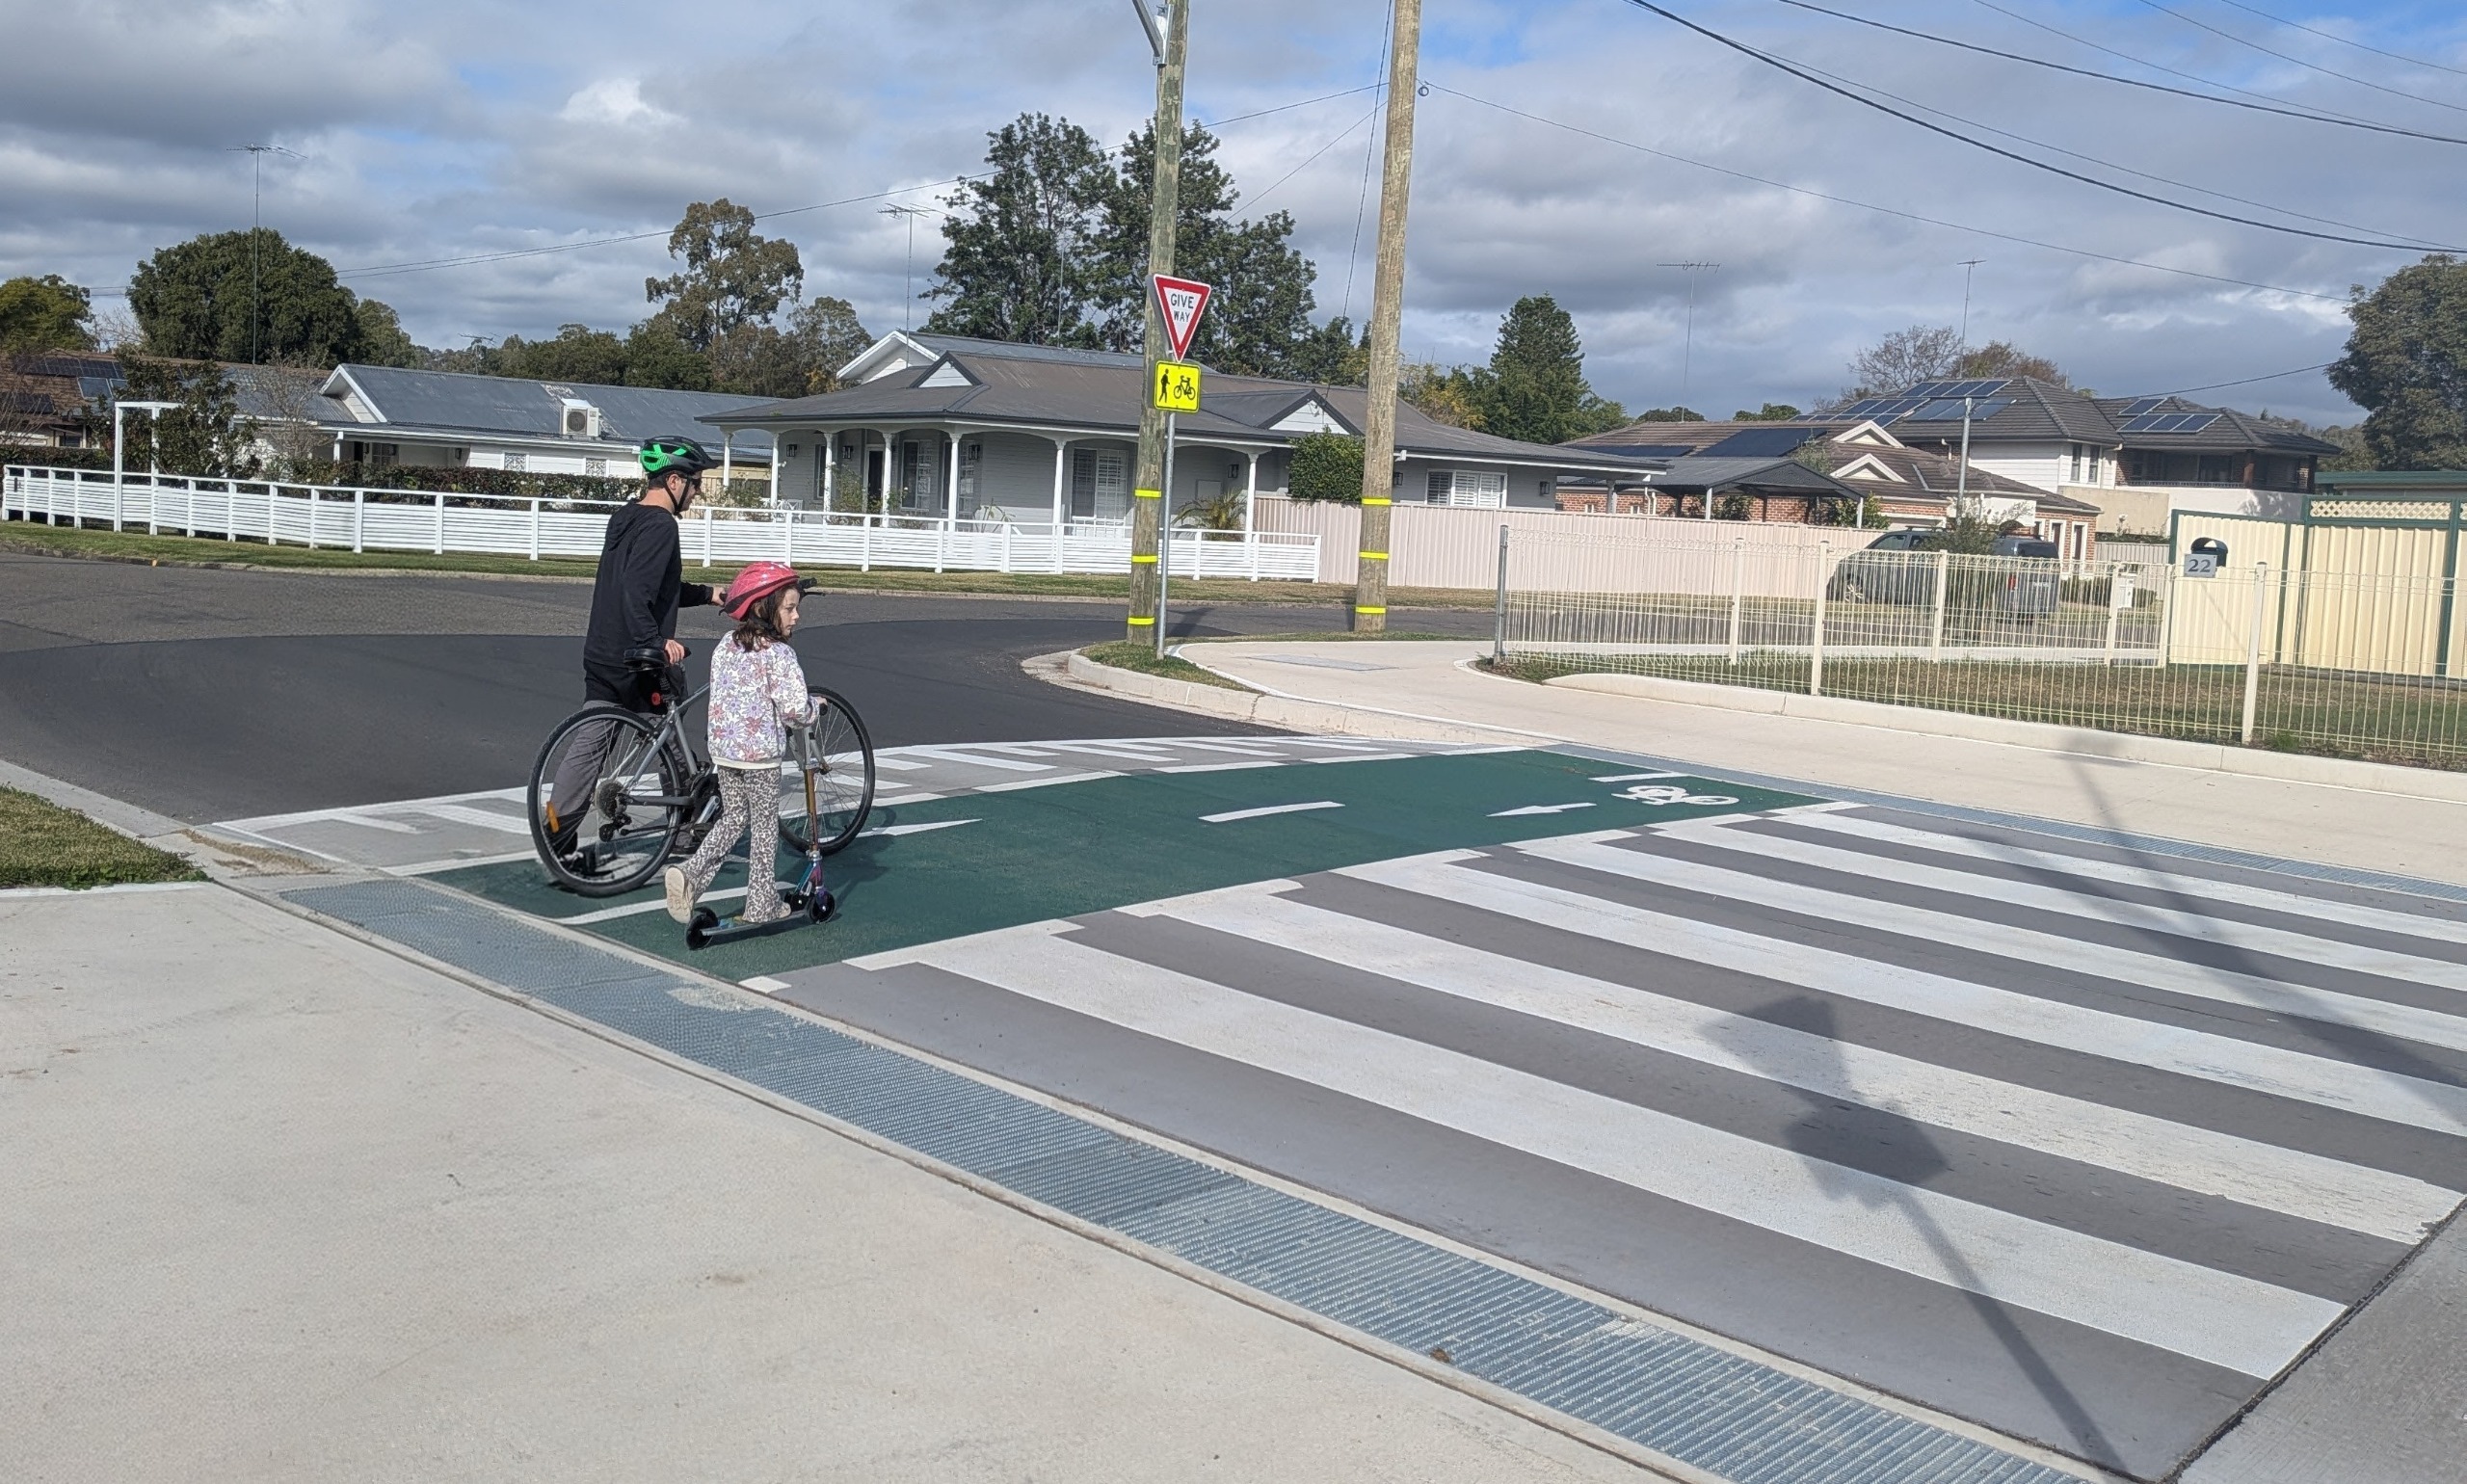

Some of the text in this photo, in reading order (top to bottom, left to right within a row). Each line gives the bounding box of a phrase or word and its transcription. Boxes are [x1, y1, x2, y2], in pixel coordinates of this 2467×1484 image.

[1170, 293, 1194, 309] GIVE
[1174, 310, 1190, 322] WAY
[2188, 558, 2211, 572] 22
